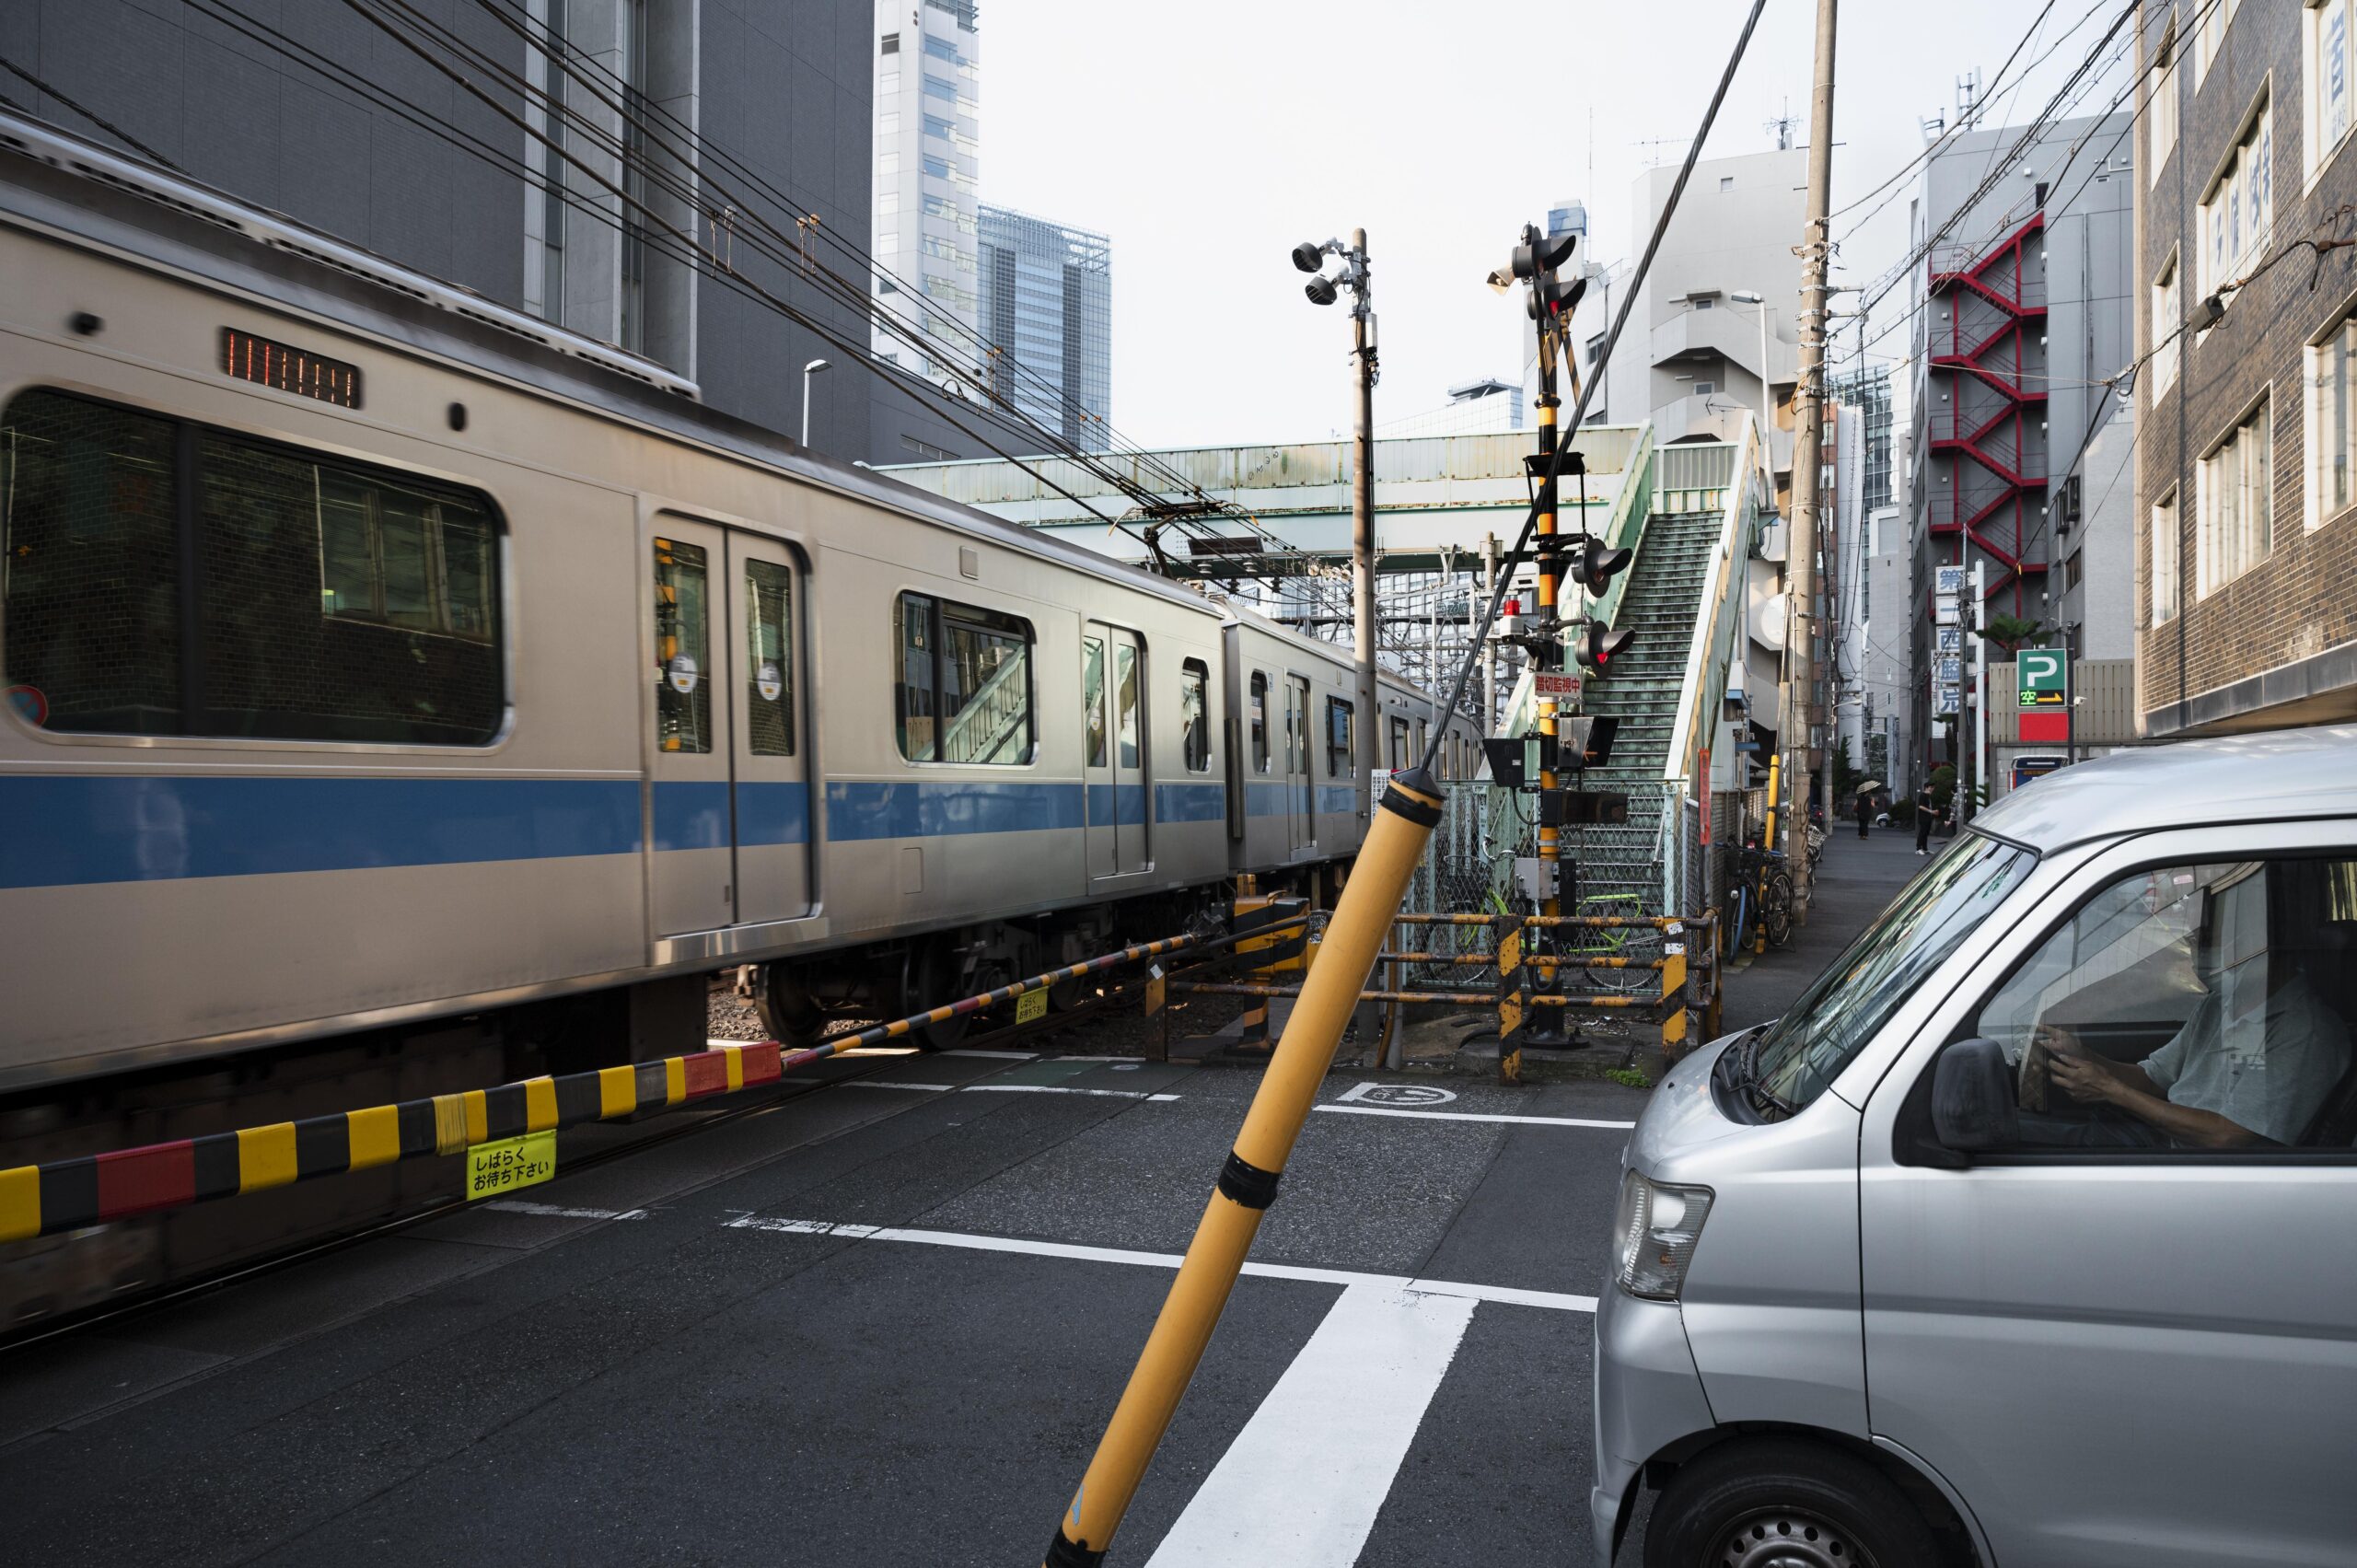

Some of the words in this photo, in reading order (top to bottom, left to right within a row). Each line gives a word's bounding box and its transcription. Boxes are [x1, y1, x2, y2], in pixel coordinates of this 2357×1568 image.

[1536, 676, 1580, 693] 踏切監視中
[2027, 656, 2058, 687] P
[2020, 690, 2037, 705] 空
[475, 1146, 526, 1172] しばらく
[473, 1161, 550, 1191] お待ち下さい
